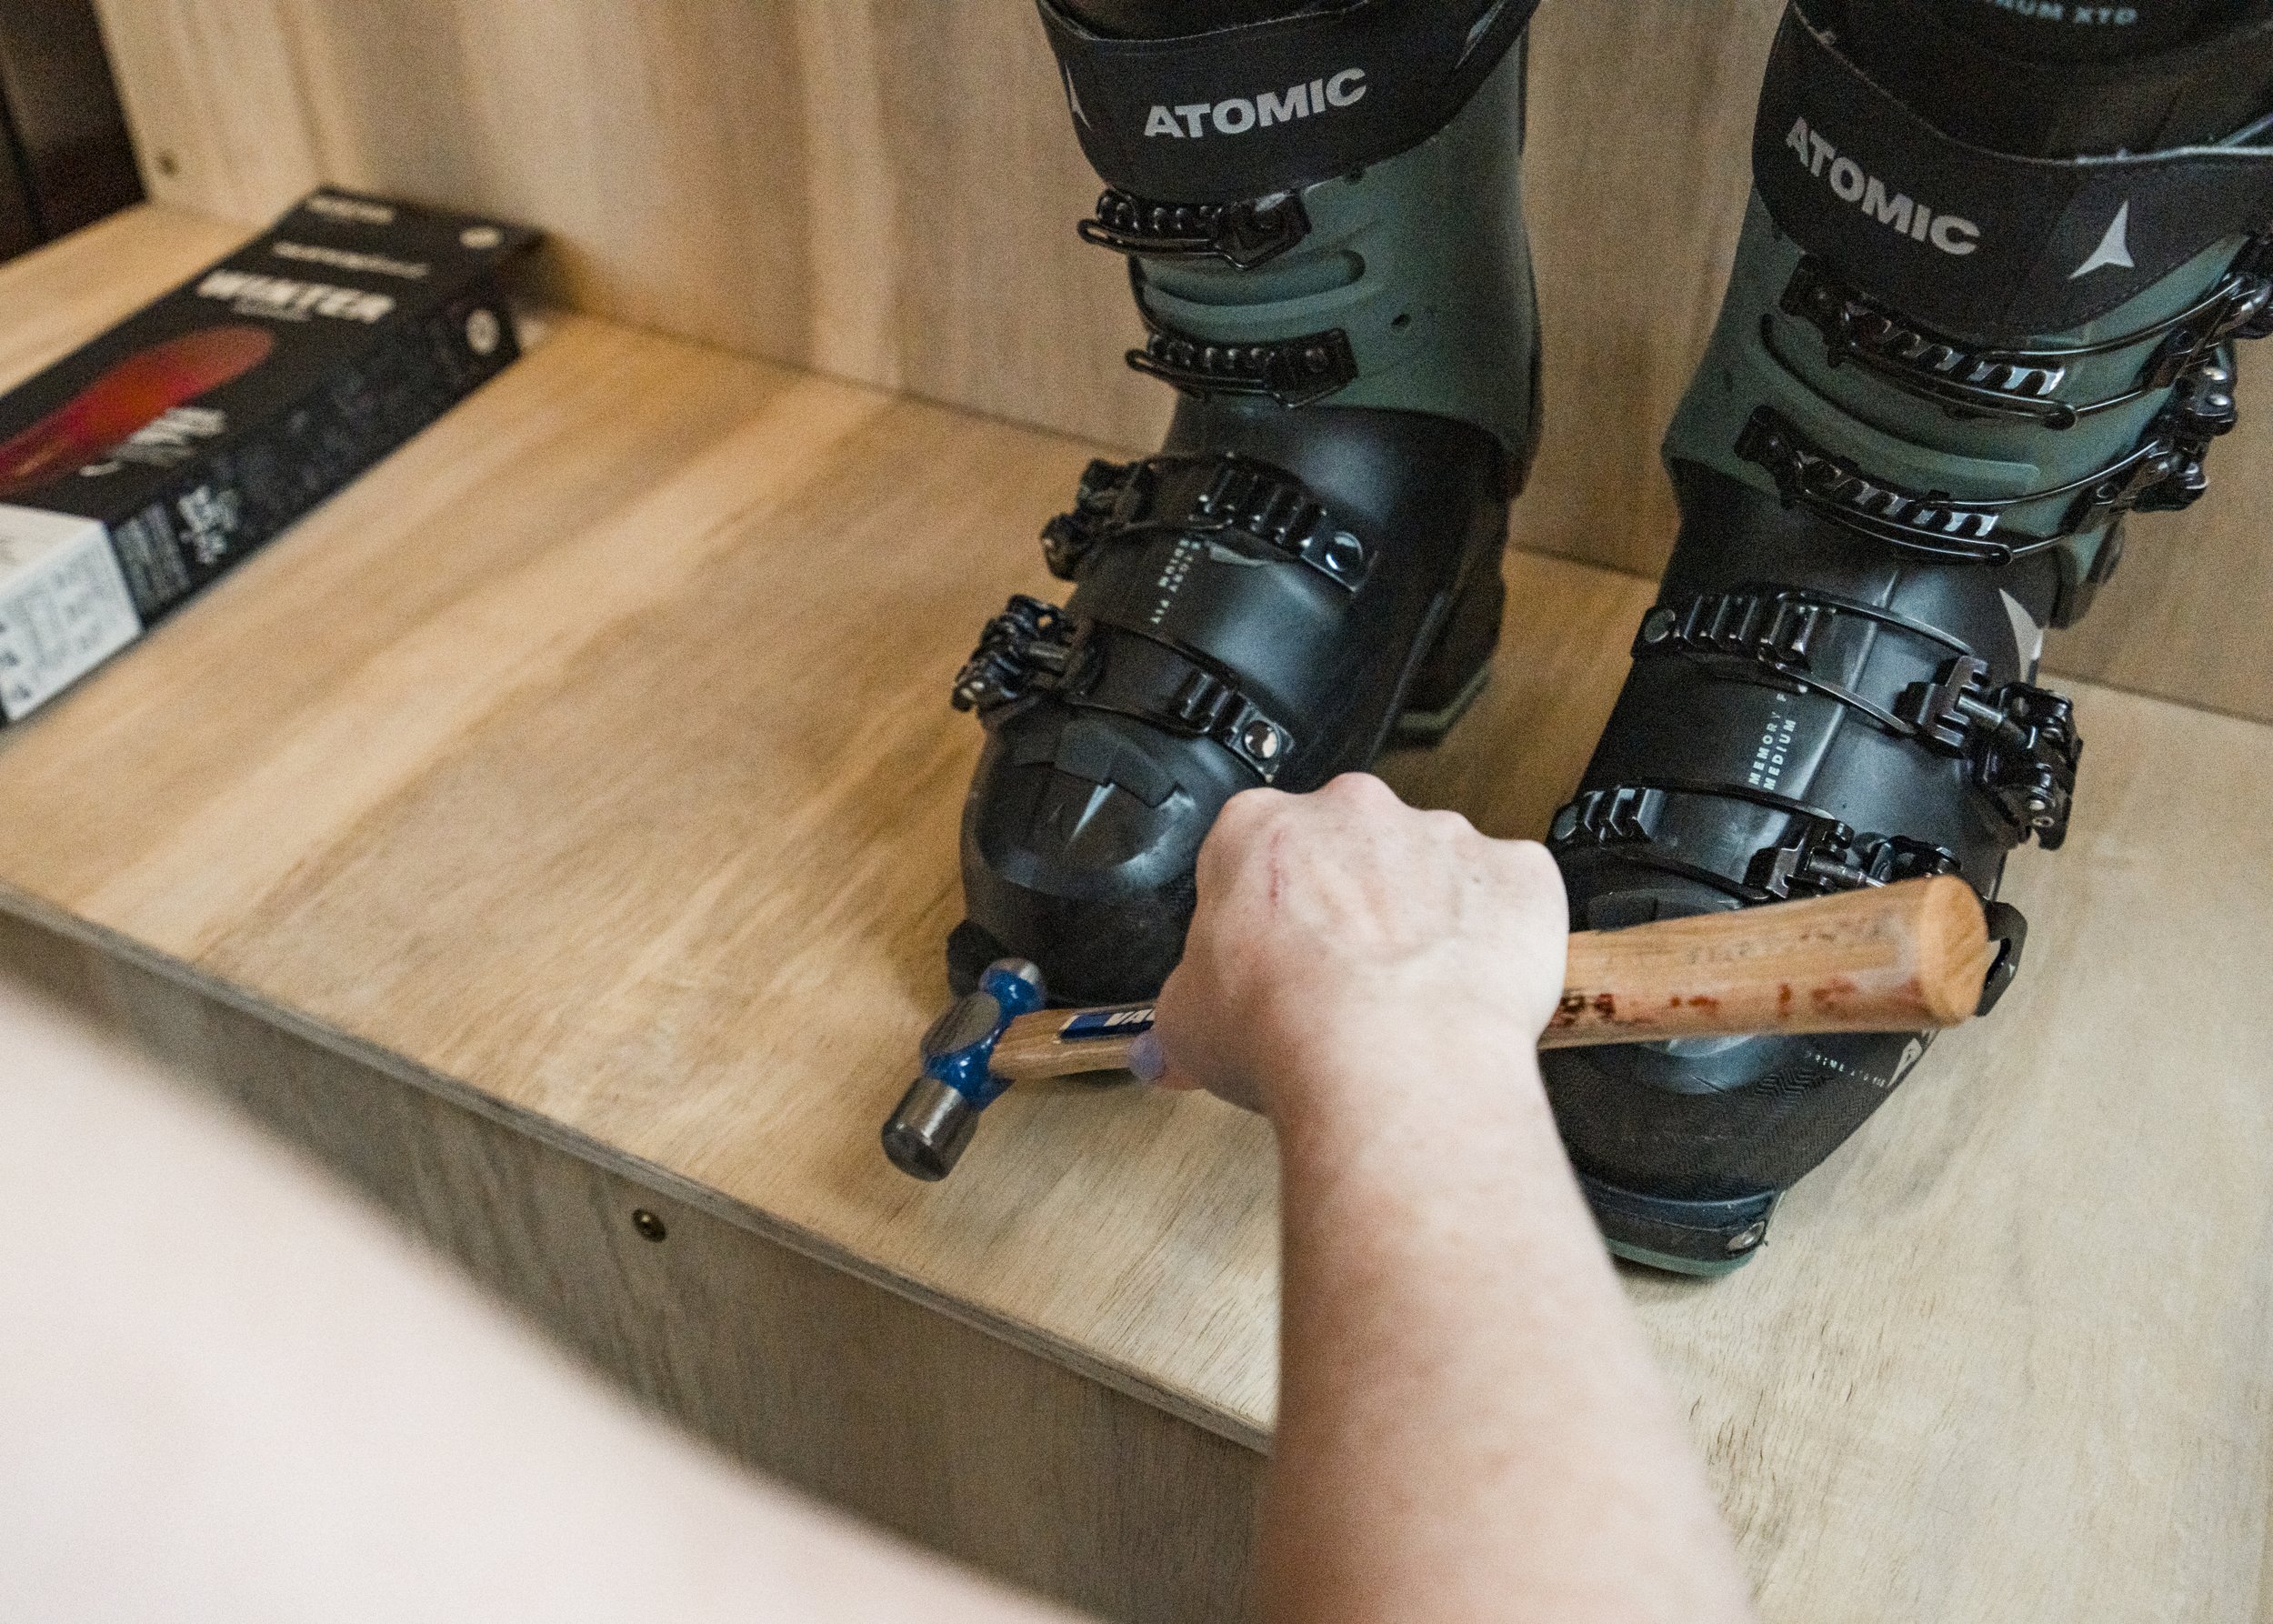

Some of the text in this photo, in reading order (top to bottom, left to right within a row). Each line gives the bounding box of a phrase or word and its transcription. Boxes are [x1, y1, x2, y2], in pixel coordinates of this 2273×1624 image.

[1144, 67, 1367, 138] ATOMIC
[1786, 115, 1980, 256] ATOMIC
[1748, 711, 1781, 785] MEMORY
[1763, 719, 1797, 791] MEDIUM
